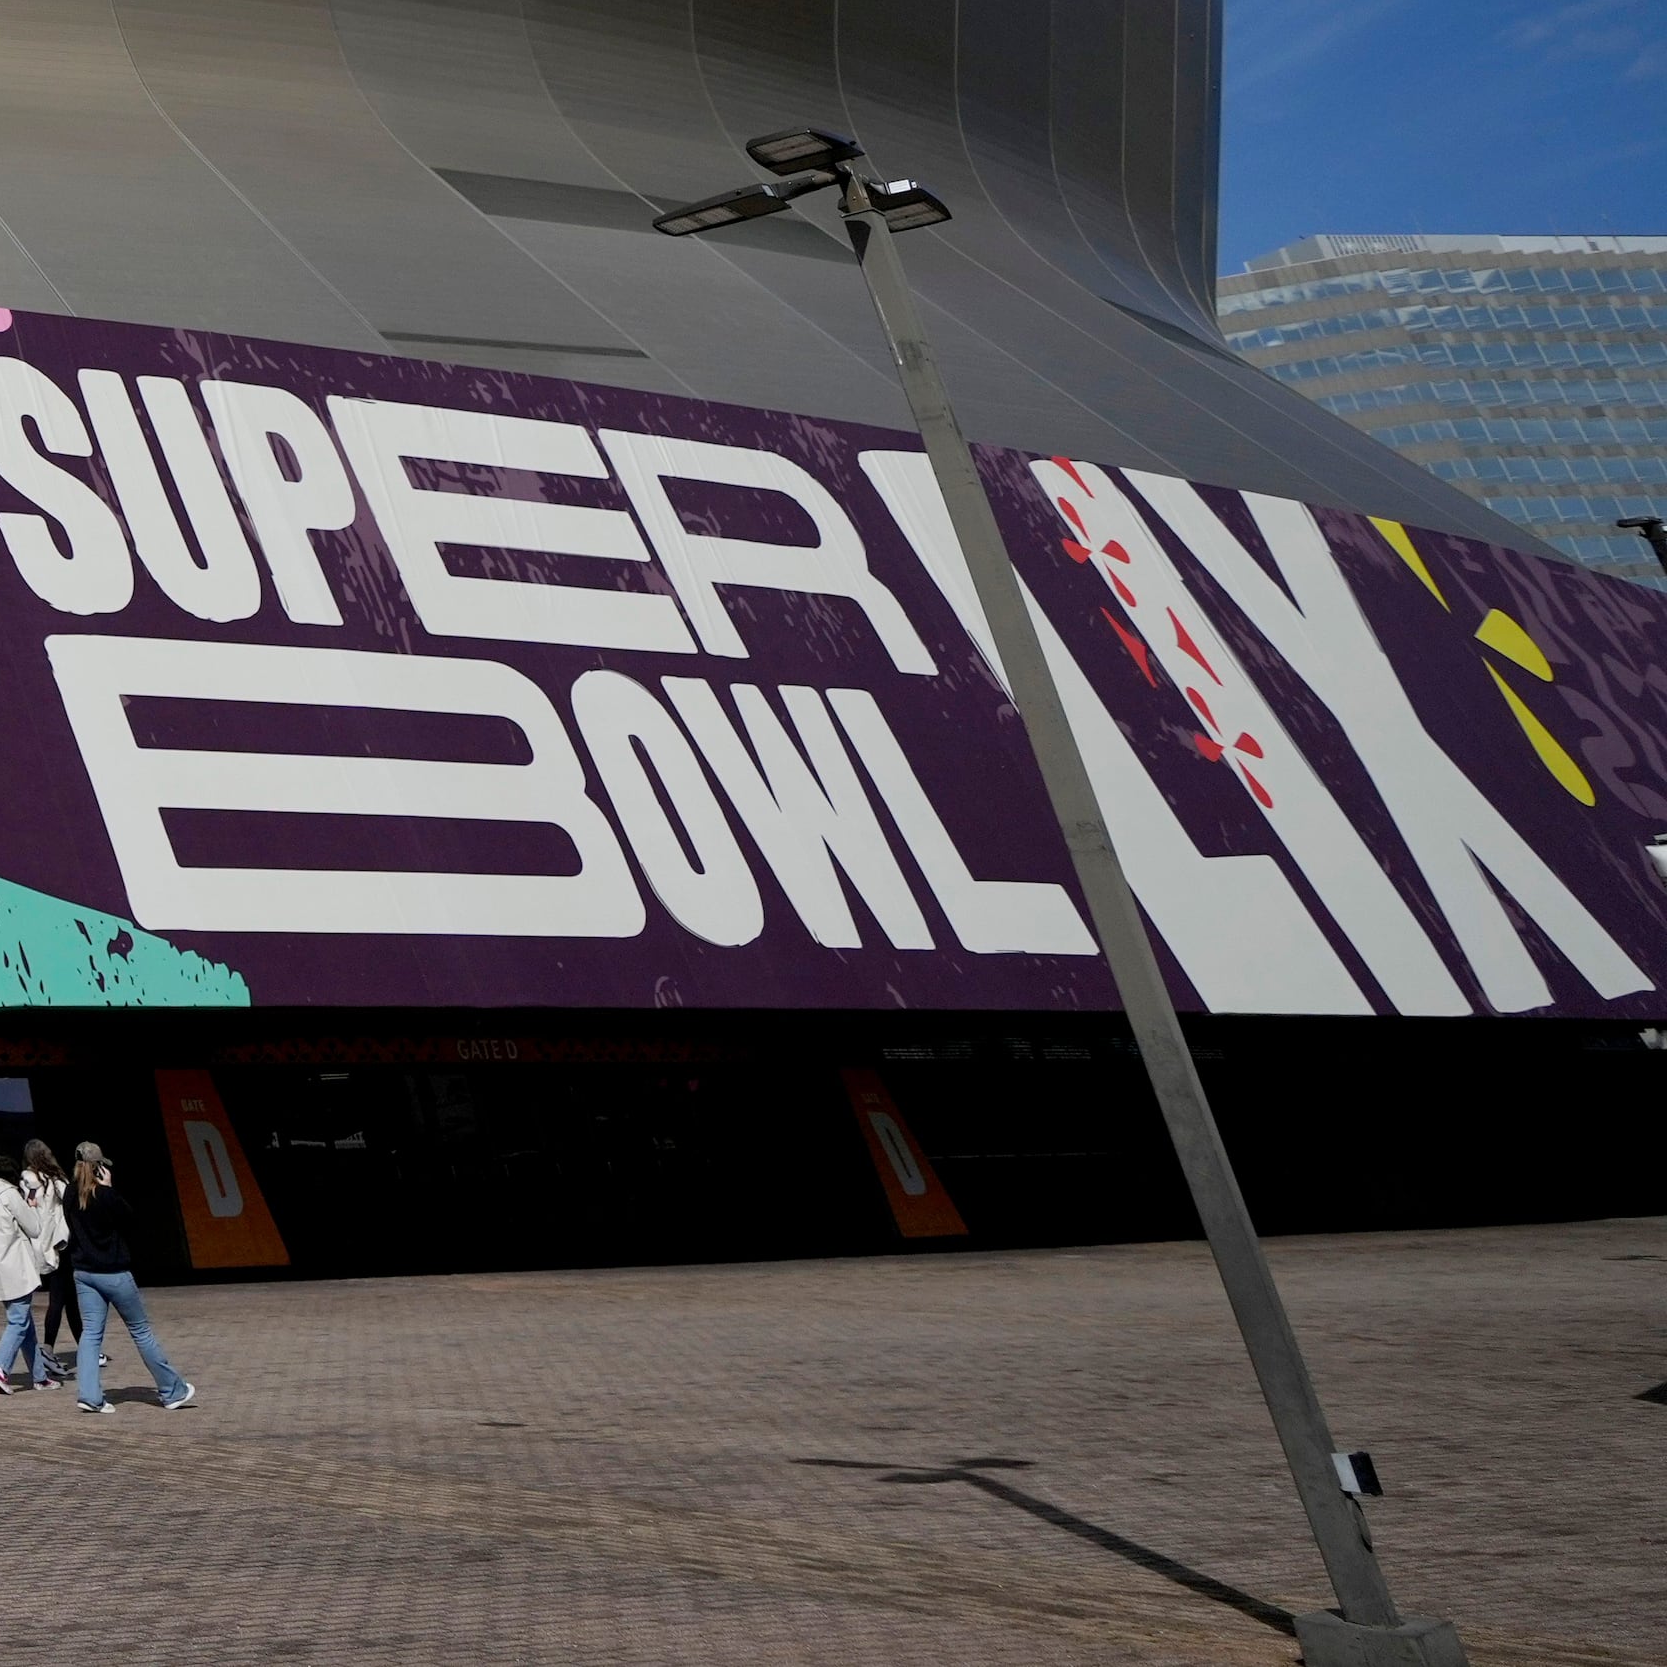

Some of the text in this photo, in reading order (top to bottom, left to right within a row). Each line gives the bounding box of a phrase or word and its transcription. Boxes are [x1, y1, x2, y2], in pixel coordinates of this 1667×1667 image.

[860, 447, 1654, 1017] LIX
[44, 635, 1099, 956] BOWL
[457, 1039, 518, 1060] GATE D
[183, 1119, 244, 1218] D
[867, 1111, 927, 1195] D
